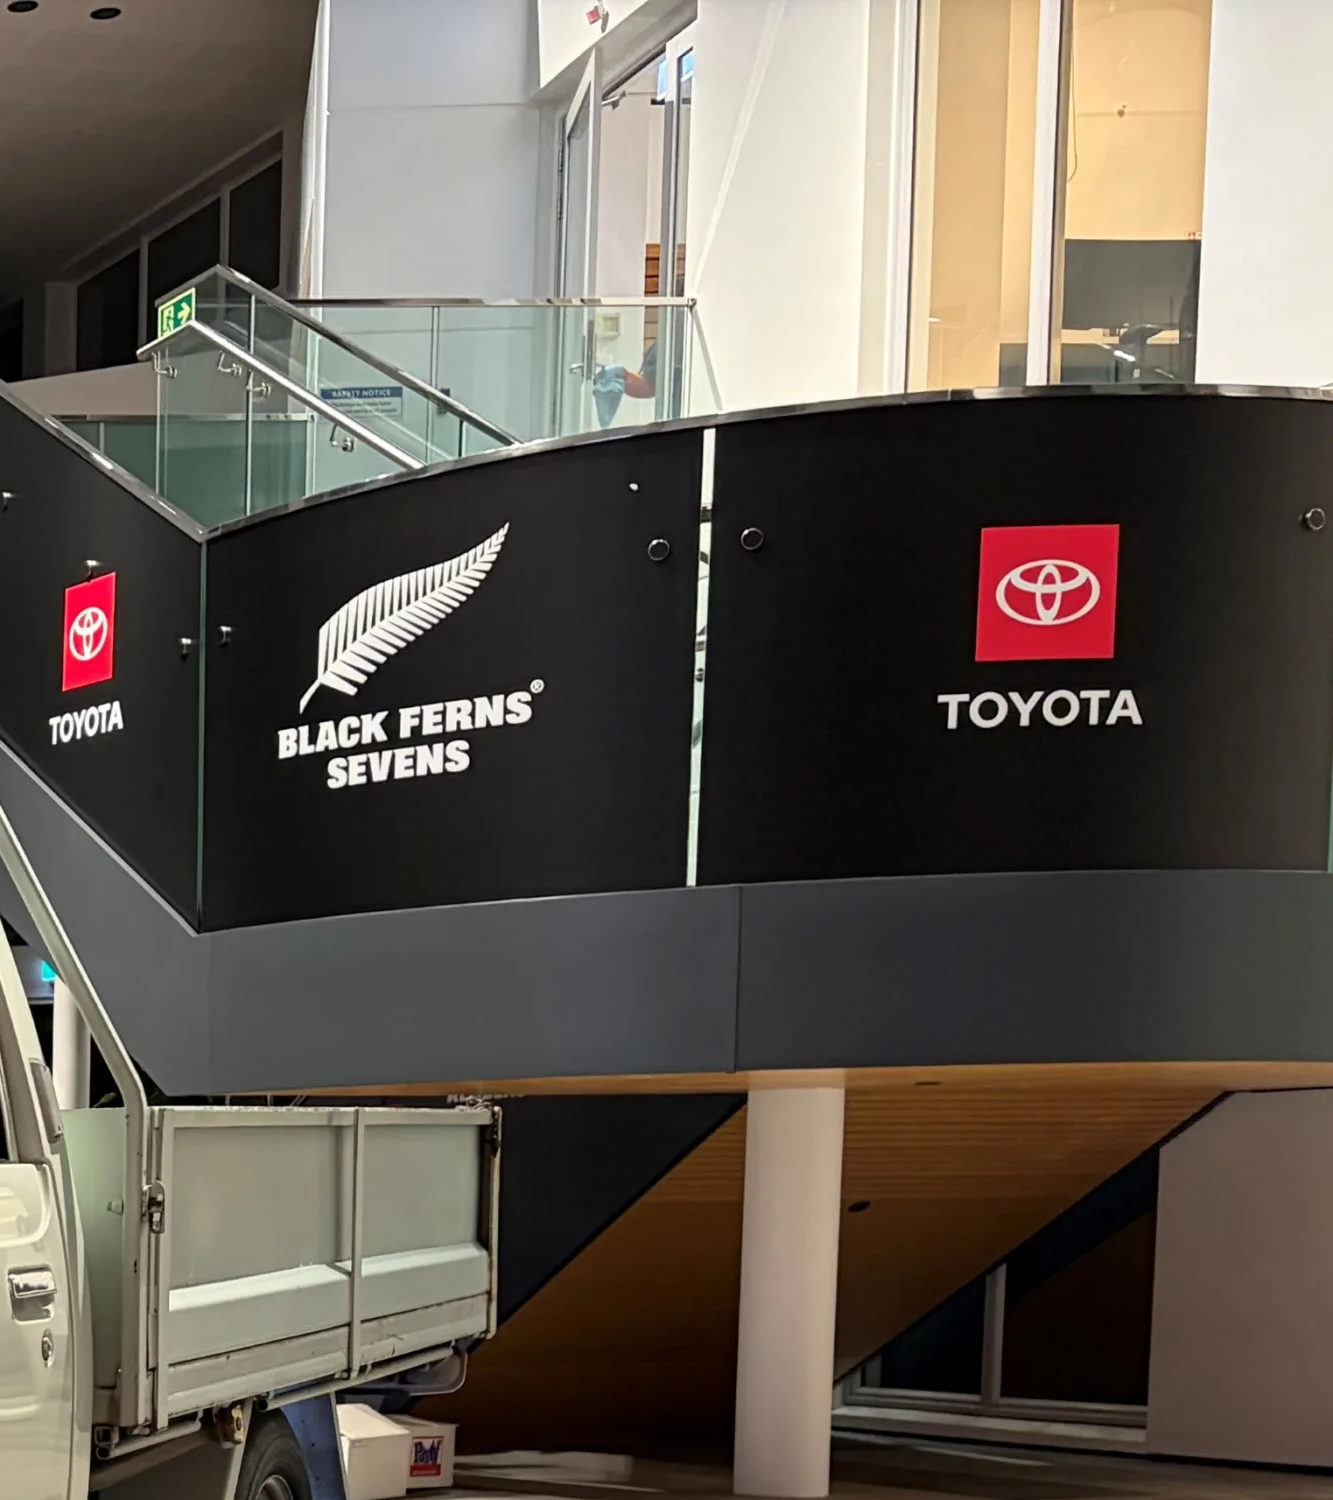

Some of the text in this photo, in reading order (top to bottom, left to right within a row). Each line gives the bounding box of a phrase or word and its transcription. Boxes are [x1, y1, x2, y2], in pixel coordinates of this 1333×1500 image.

[362, 388, 392, 397] NOTICE
[48, 700, 125, 746] TOYOTA
[937, 689, 1144, 730] TOYOTA
[277, 710, 390, 761] BLACK
[326, 740, 471, 789] SEVENS
